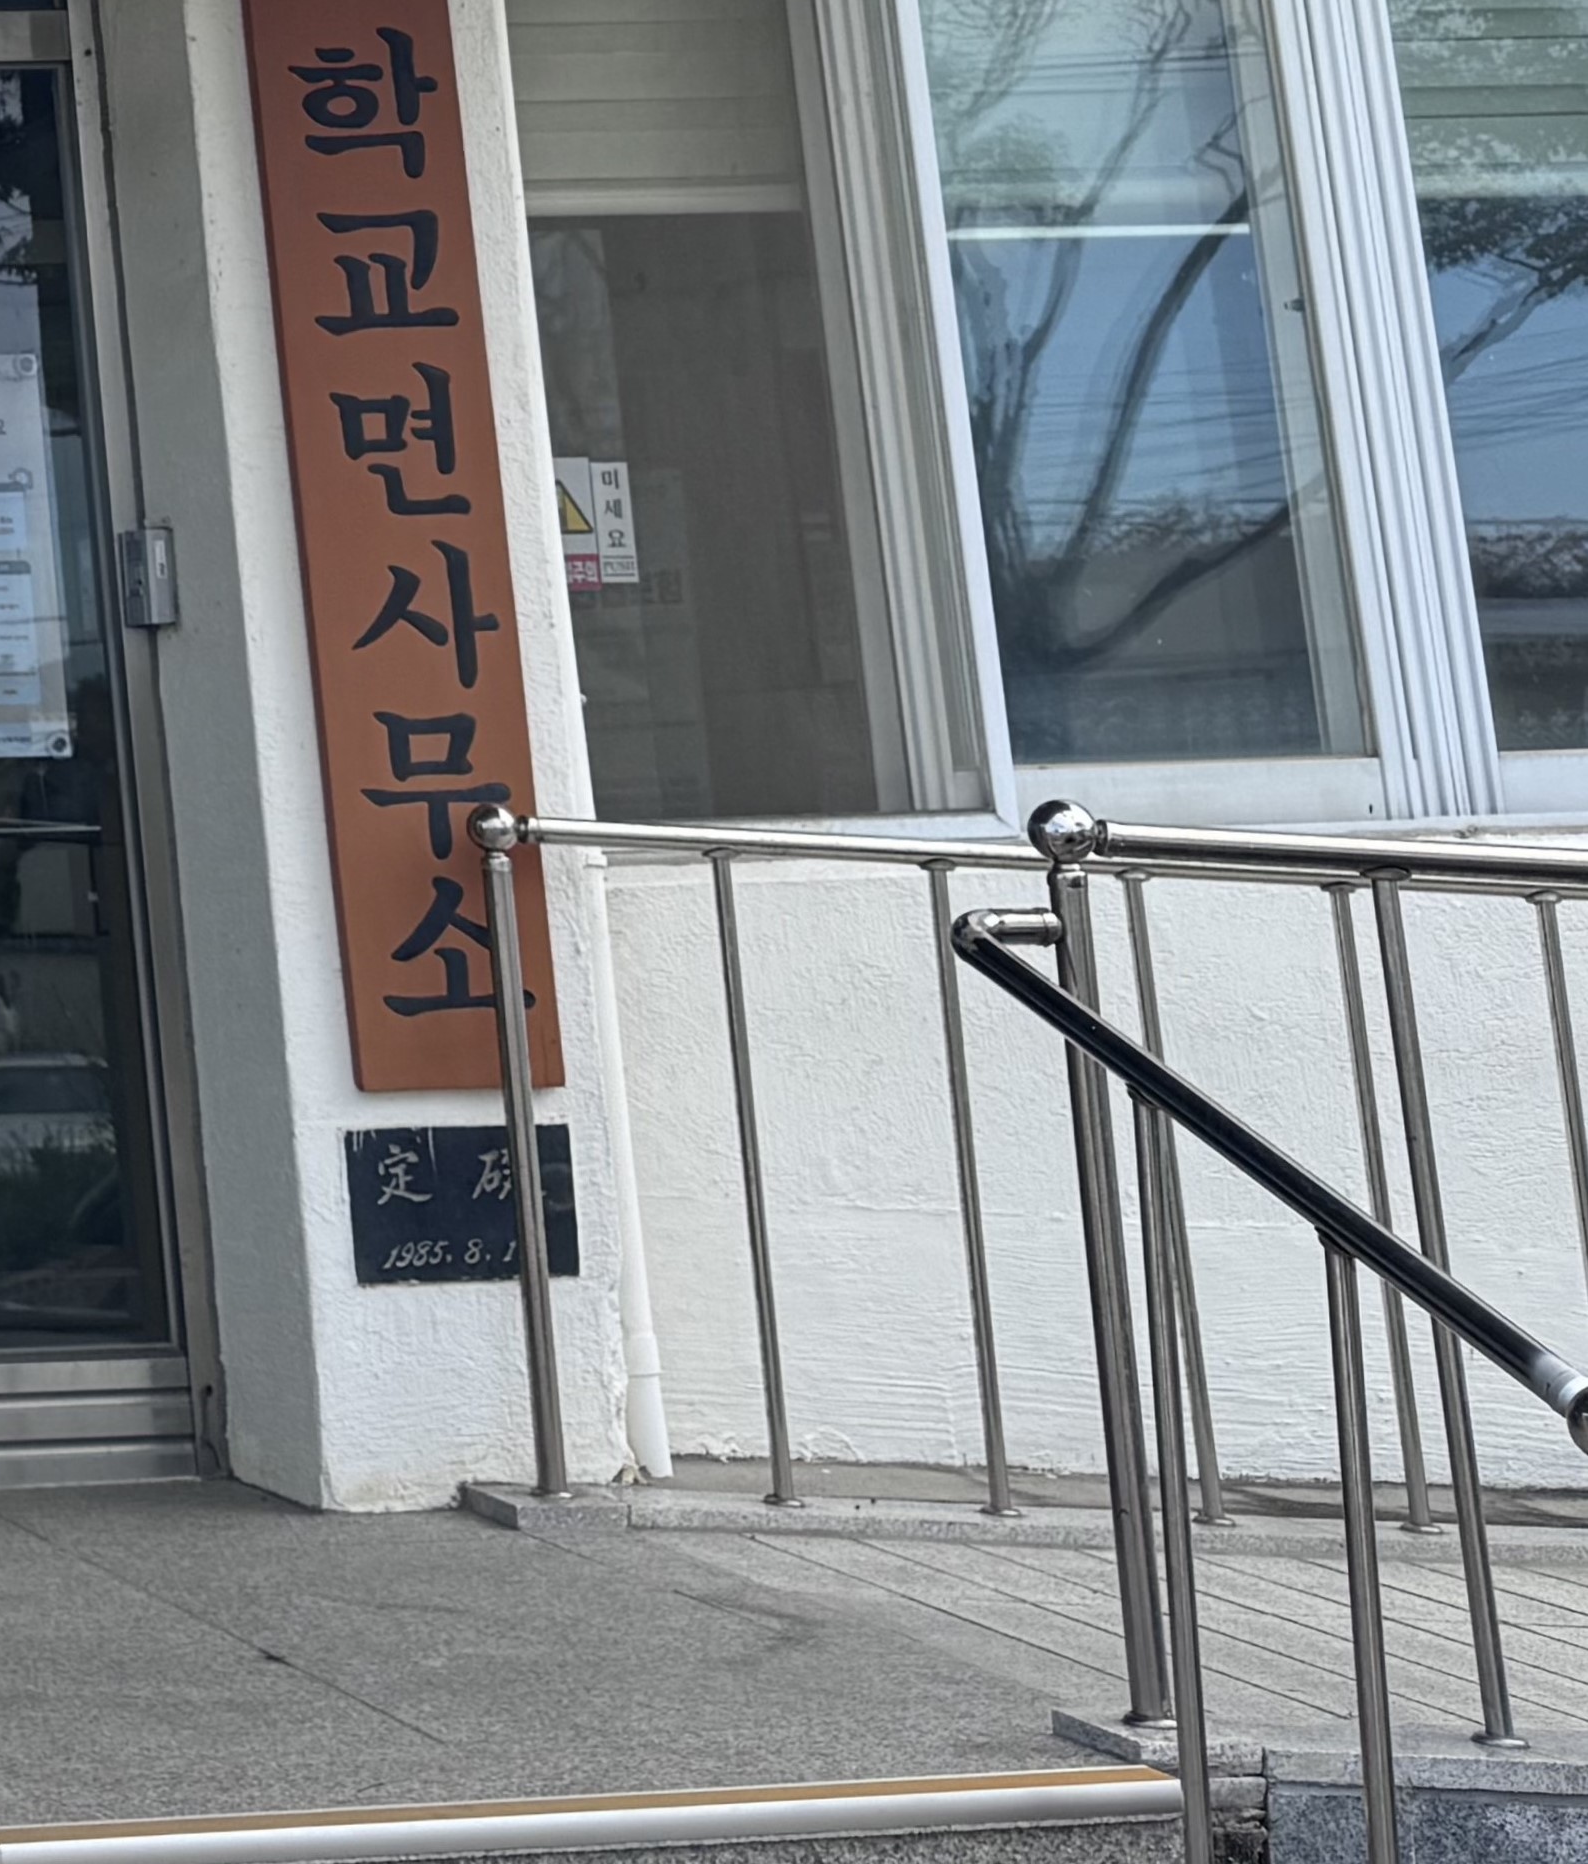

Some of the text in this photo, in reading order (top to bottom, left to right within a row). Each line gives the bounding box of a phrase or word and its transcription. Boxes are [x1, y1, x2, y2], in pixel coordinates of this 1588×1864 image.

[287, 25, 535, 1018] 학교면사무소
[383, 1241, 453, 1270] 1985.
[464, 1238, 491, 1264] 8.
